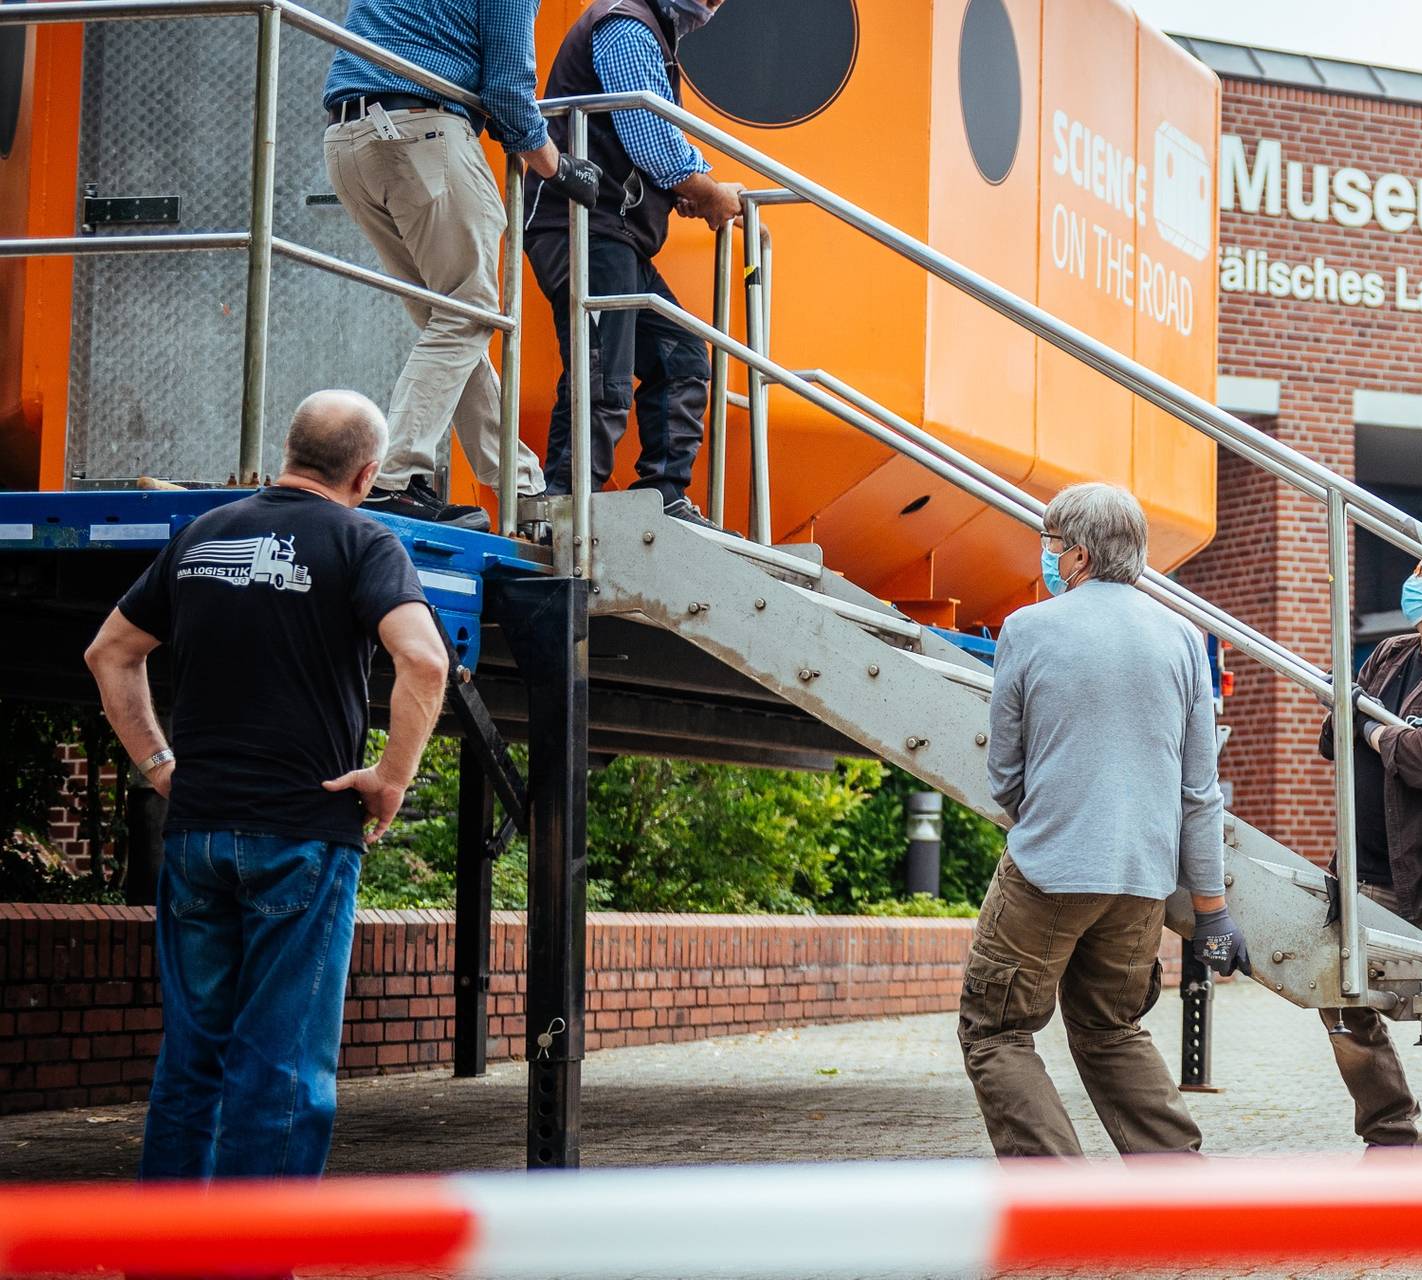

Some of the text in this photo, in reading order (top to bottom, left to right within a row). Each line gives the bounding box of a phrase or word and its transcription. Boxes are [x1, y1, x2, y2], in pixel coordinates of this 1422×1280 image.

[1053, 110, 1147, 227] SCIENCE
[1052, 203, 1193, 337] ON THE ROAD
[1218, 246, 1386, 308] älisches
[193, 566, 250, 577] LOGISTIK
